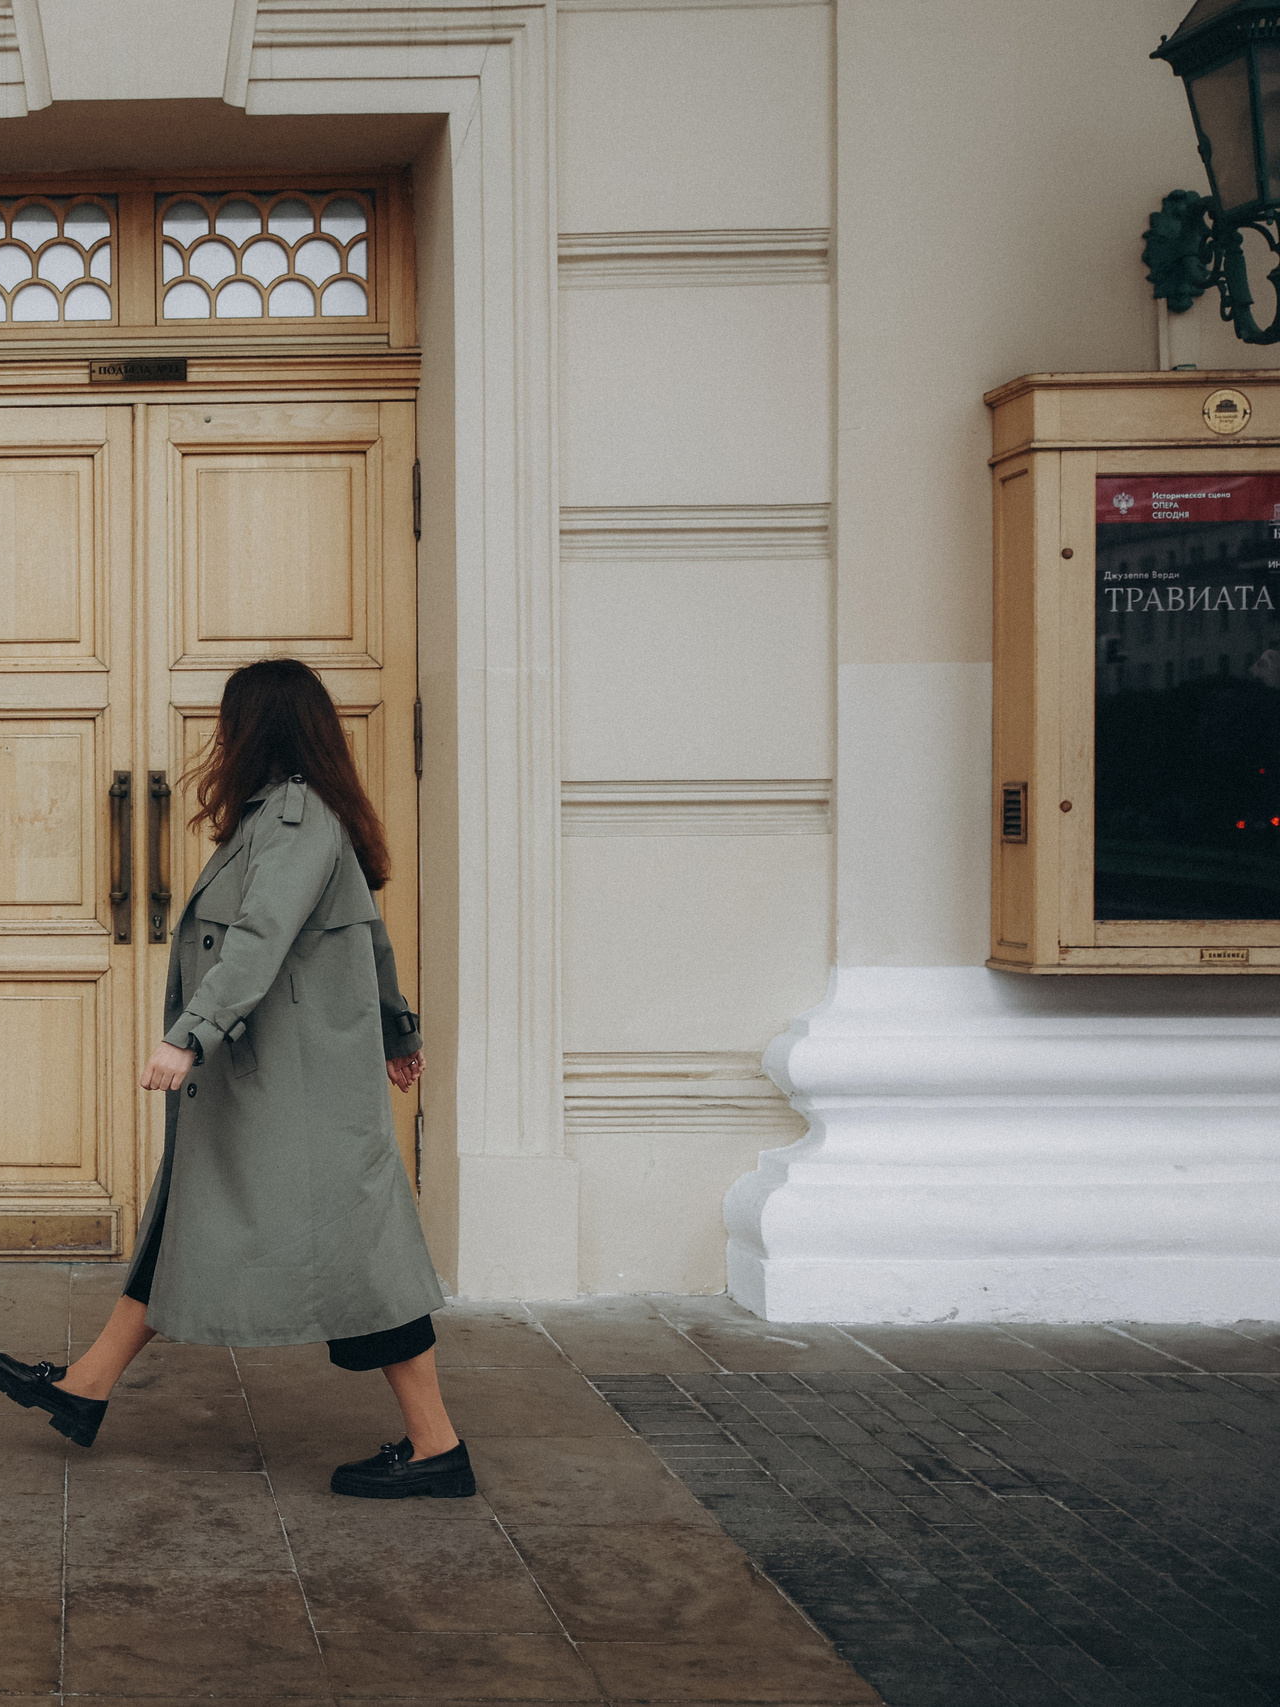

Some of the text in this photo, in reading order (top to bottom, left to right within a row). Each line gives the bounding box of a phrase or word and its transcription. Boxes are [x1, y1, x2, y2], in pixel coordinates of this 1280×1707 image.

[1151, 491, 1231, 500] Историческая сцена
[1152, 501, 1179, 510] ОПЕРА
[1152, 511, 1190, 519] СЕГОДНЯ
[1103, 570, 1180, 581] Джузеппе Верди
[1104, 585, 1276, 613] ТРАВИАТА
